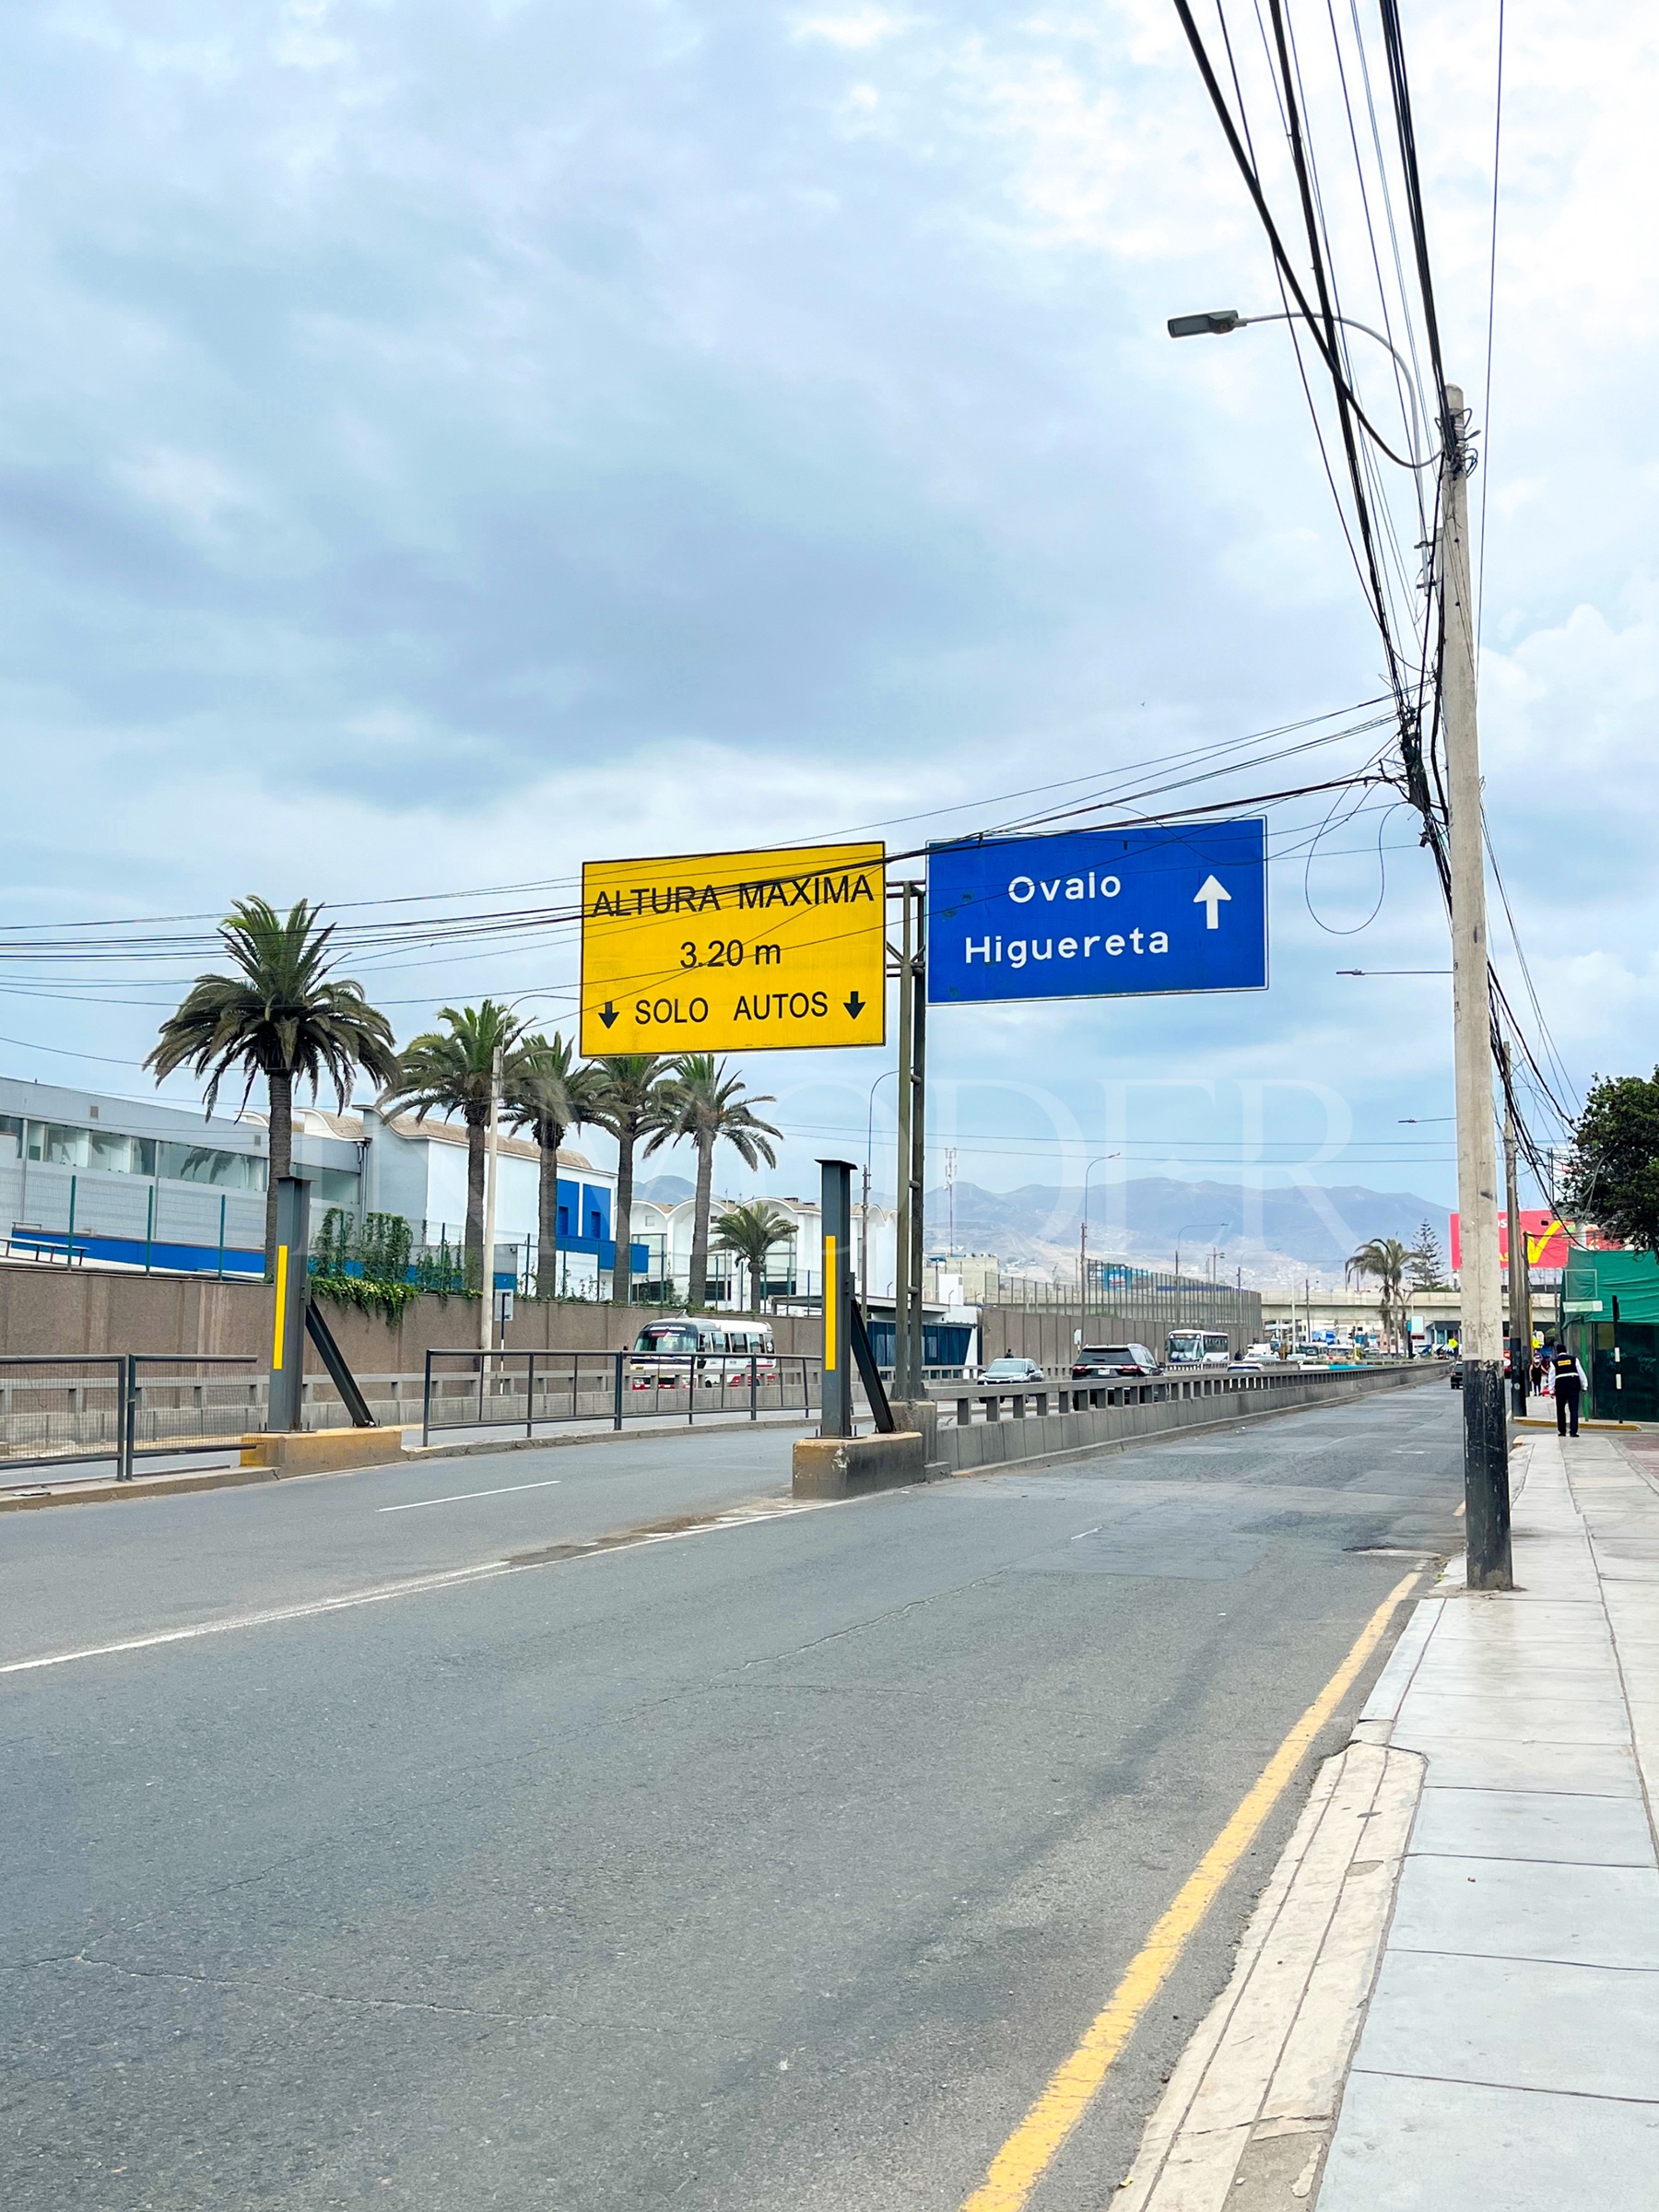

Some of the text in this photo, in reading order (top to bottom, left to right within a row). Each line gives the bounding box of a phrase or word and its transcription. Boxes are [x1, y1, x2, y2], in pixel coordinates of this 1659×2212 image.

[592, 874, 875, 918] ALTURA MAXIMA
[1007, 871, 1122, 903] Ovalo
[679, 939, 782, 969] 3.20 m
[965, 926, 1170, 969] Higuereta
[634, 991, 829, 1025] SOLO AUTOS
